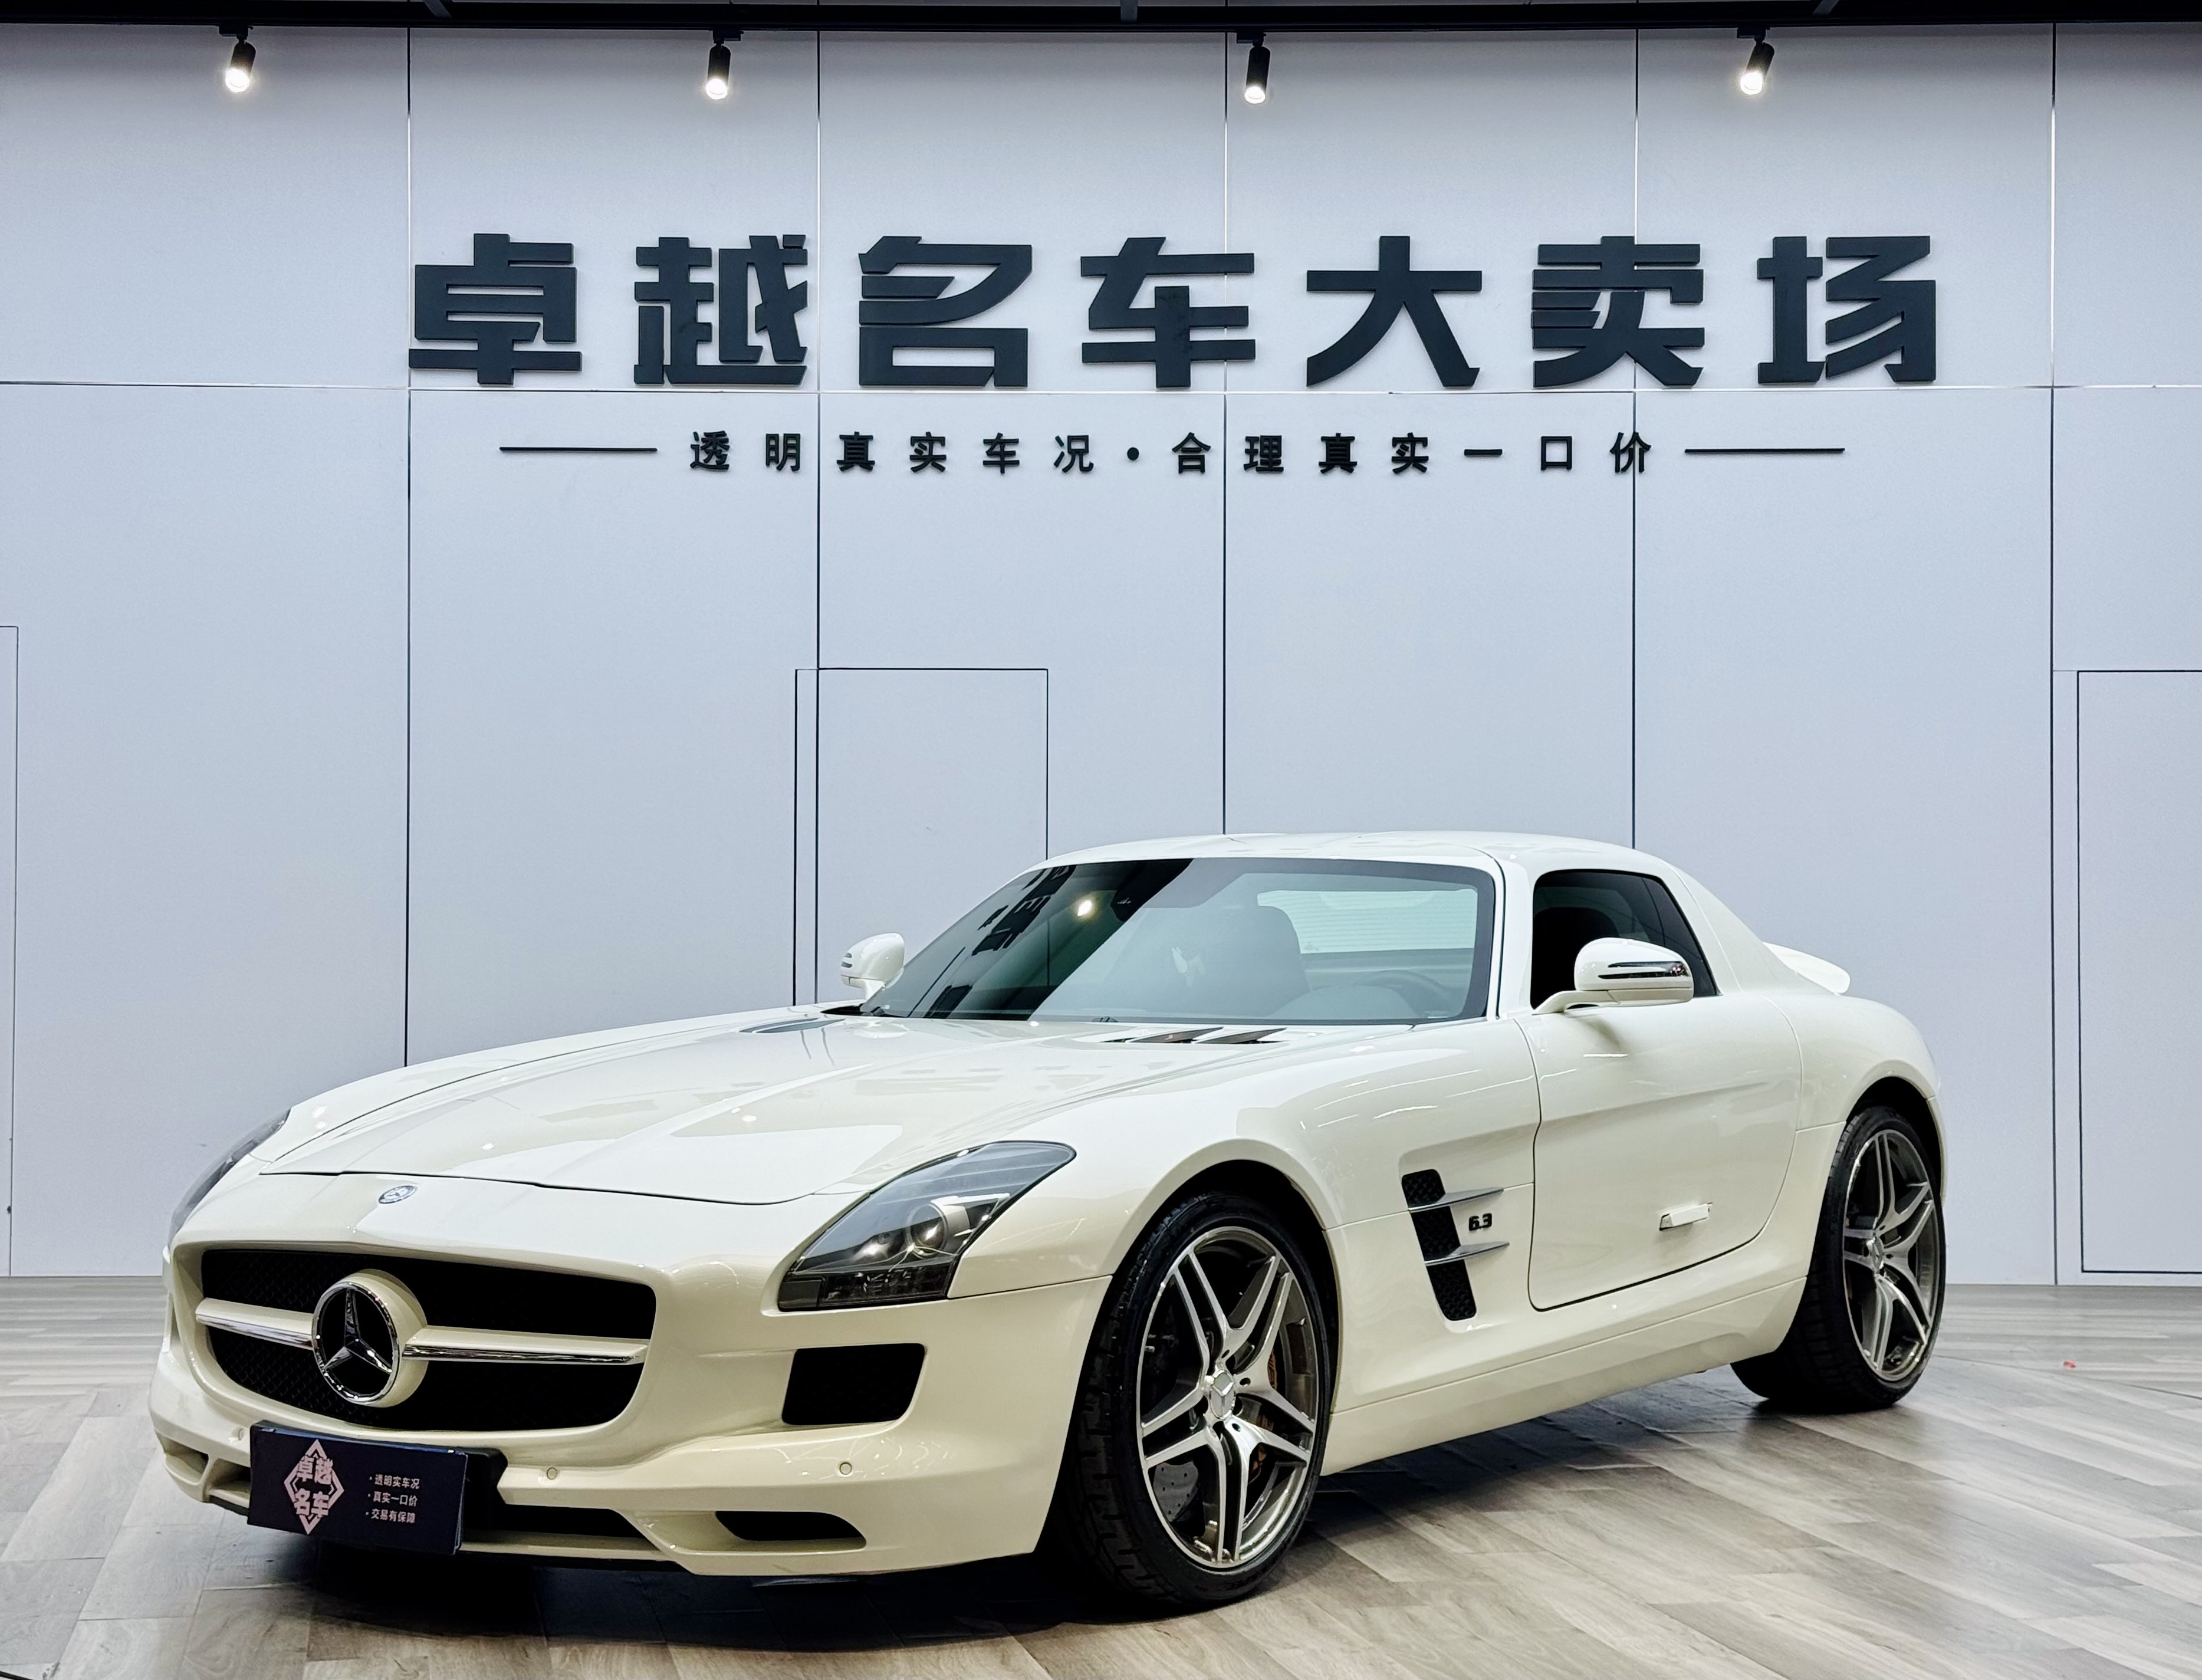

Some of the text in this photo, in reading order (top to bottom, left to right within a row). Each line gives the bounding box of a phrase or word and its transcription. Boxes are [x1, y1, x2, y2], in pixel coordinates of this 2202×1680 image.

[408, 233, 1937, 389] 卓越名车大卖场
[1468, 1213, 1493, 1231] 6.3
[297, 1455, 333, 1485] 卓越
[374, 1474, 420, 1490] 透明实车况
[294, 1488, 330, 1518] 名车
[373, 1491, 418, 1507] 真实一口价
[370, 1508, 416, 1524] 交易有保障
